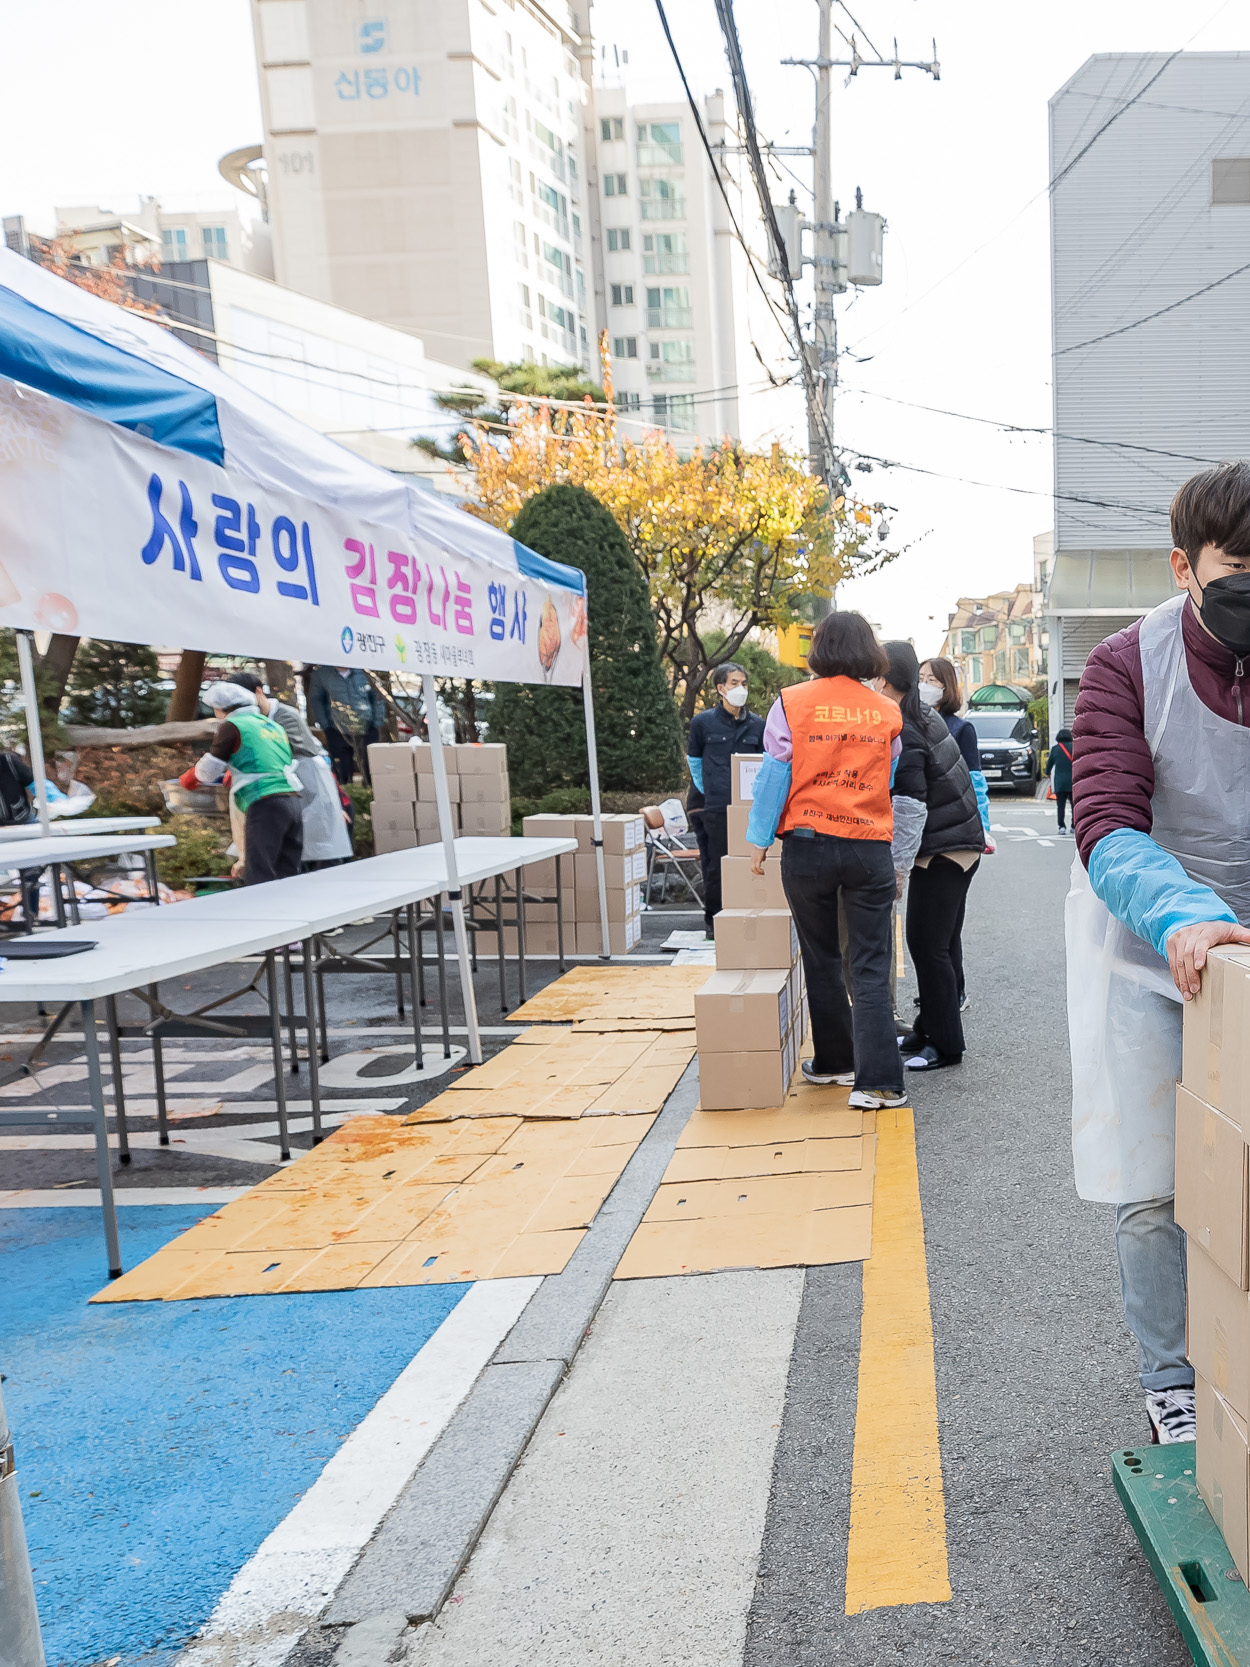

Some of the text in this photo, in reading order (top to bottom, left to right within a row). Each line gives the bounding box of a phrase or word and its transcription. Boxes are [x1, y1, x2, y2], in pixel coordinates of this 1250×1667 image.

[334, 66, 422, 101] 신동아
[141, 473, 528, 645] 사랑의 김장나눔 행사
[356, 632, 386, 655] 광진구
[814, 705, 882, 725] 코로나19
